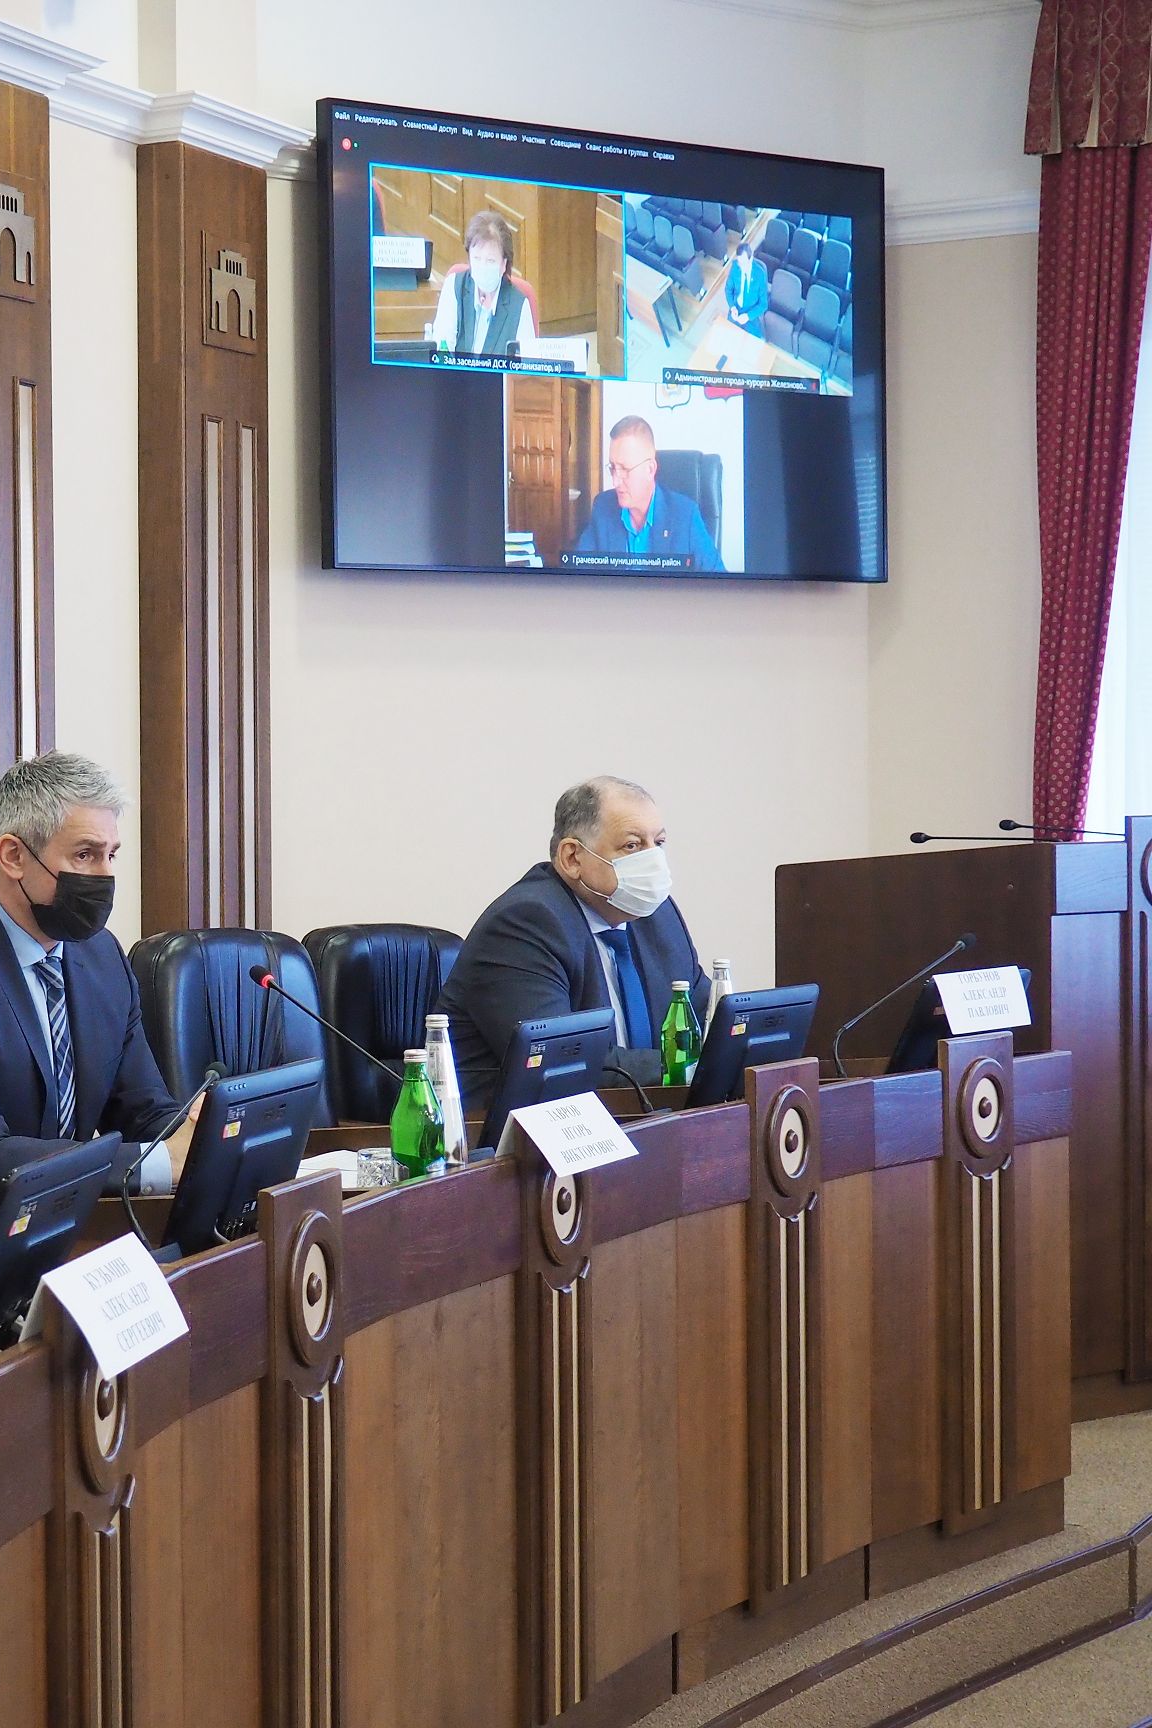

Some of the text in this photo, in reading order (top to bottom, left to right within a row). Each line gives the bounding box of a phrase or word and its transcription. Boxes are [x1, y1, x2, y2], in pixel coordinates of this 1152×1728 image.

[334, 111, 351, 121] Файл
[354, 114, 398, 127] Редактировать
[402, 120, 438, 132] Совместный
[438, 126, 458, 135] доступ
[461, 127, 473, 137] Вид
[476, 129, 495, 139] Аудио
[500, 133, 518, 142] видео
[550, 138, 582, 150] Совещание
[585, 142, 602, 152] Сеанс
[602, 145, 623, 155] работы
[652, 150, 675, 161] Справка
[443, 355, 456, 366] Зал
[456, 357, 492, 369] заседаний
[492, 358, 507, 370] ДСК
[509, 360, 554, 373] (организатор,
[674, 372, 723, 386] Администрация
[723, 376, 770, 390] города-курорта
[572, 555, 681, 569] Грачевский муниципальный район
[958, 970, 1001, 984] ГОРБУНОВ
[962, 987, 1007, 1001] АЛЕКСАНДР
[967, 1004, 1010, 1019] ПАВЛОВИЧ
[545, 1104, 581, 1123] ЛАВРОВ
[561, 1123, 592, 1141] ИГОРЬ
[560, 1138, 619, 1164] ВИКТОРОВИЧ
[82, 1256, 132, 1291] КУЗЬМИН
[101, 1281, 151, 1321] АЛЕКСАНДР
[116, 1310, 166, 1353] СЕРГЕЕВИЧ
